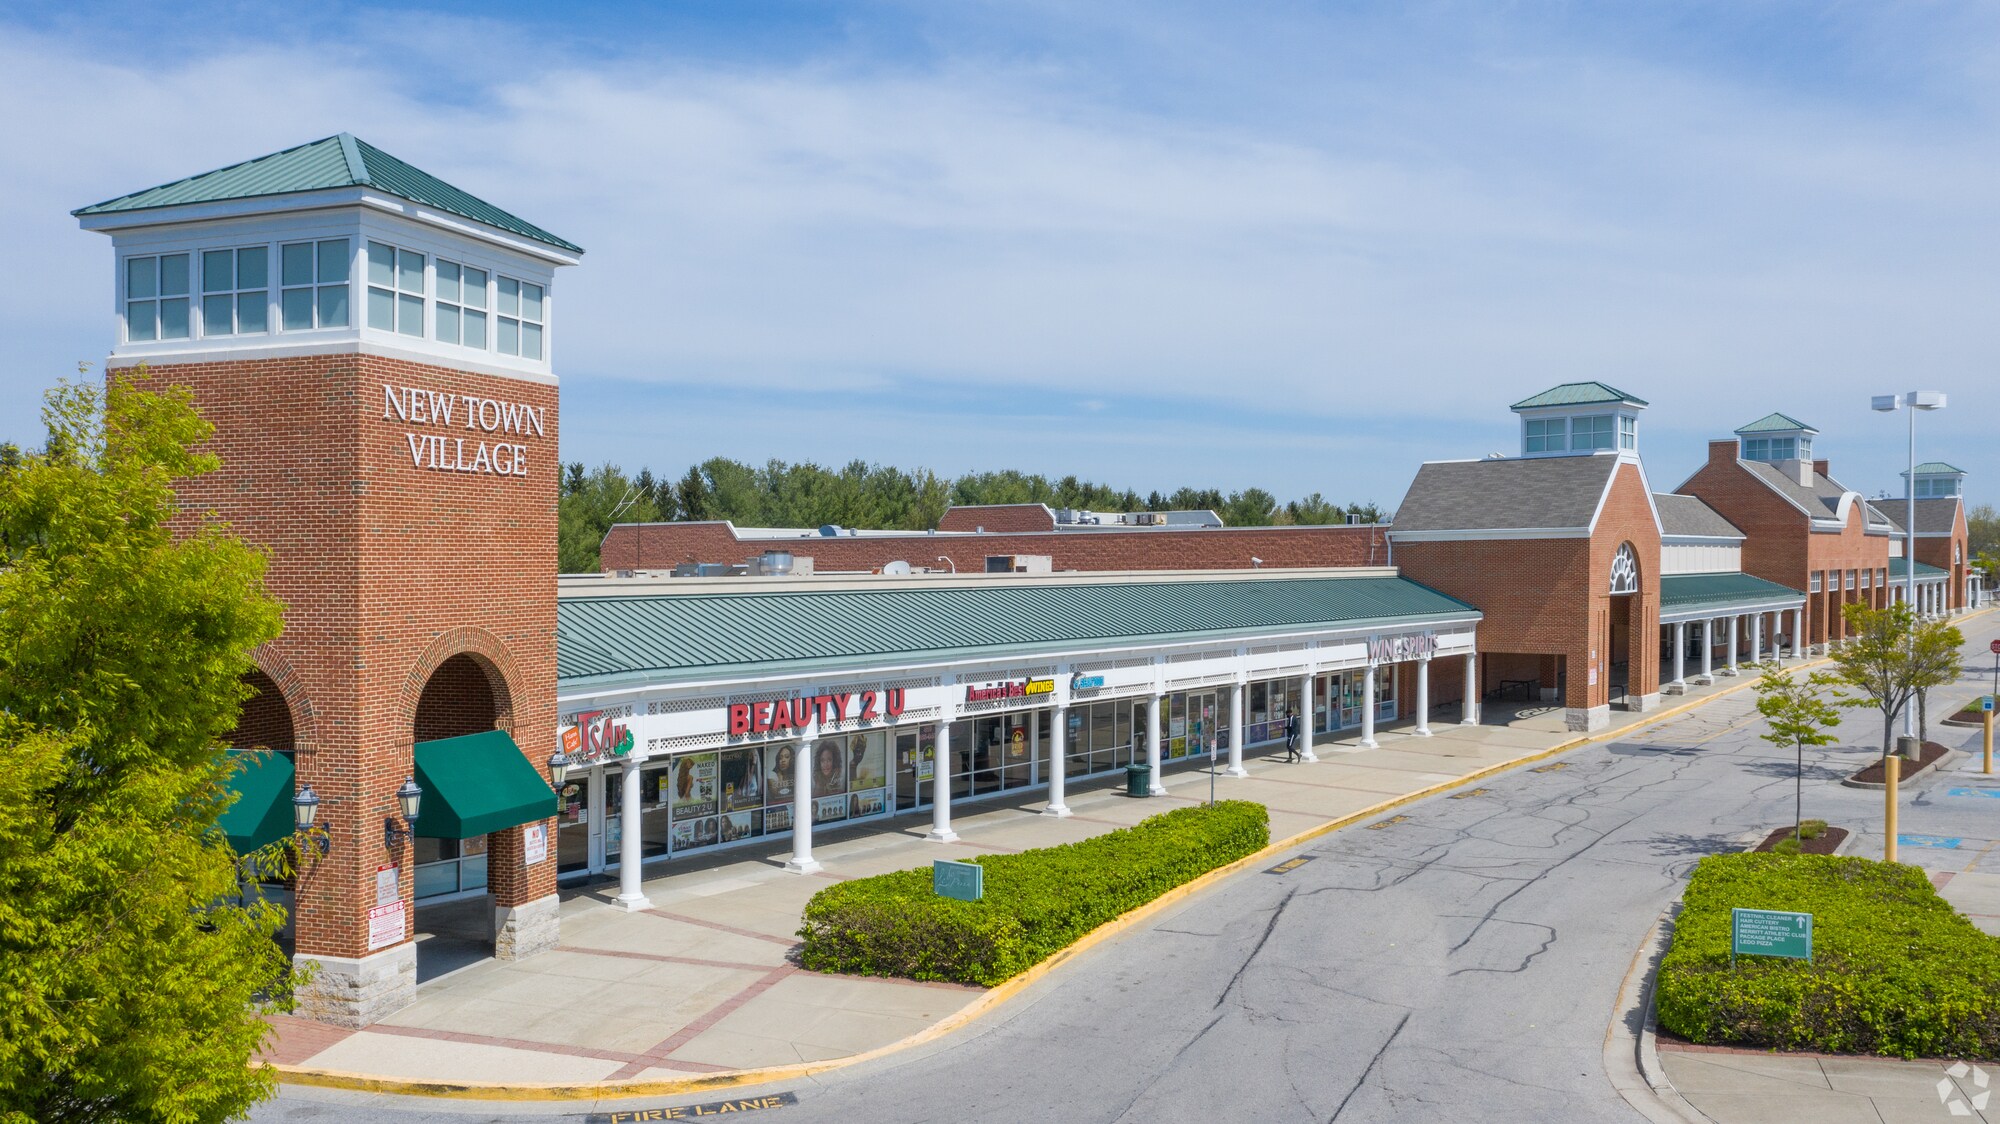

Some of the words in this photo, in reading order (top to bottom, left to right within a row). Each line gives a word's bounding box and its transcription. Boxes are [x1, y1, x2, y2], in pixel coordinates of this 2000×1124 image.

[382, 384, 456, 426] NEW
[461, 396, 545, 437] TOWN
[406, 433, 527, 476] VILLAGE
[1402, 634, 1438, 656] SPIRITS
[1009, 681, 1025, 697] Best
[1030, 679, 1054, 695] WINGS
[729, 692, 852, 735] BEAUTY
[861, 690, 877, 720] 2
[887, 688, 905, 717] U
[675, 805, 701, 816] BEAUTY
[611, 1108, 686, 1124] FIRE
[696, 1097, 784, 1116] LANE
